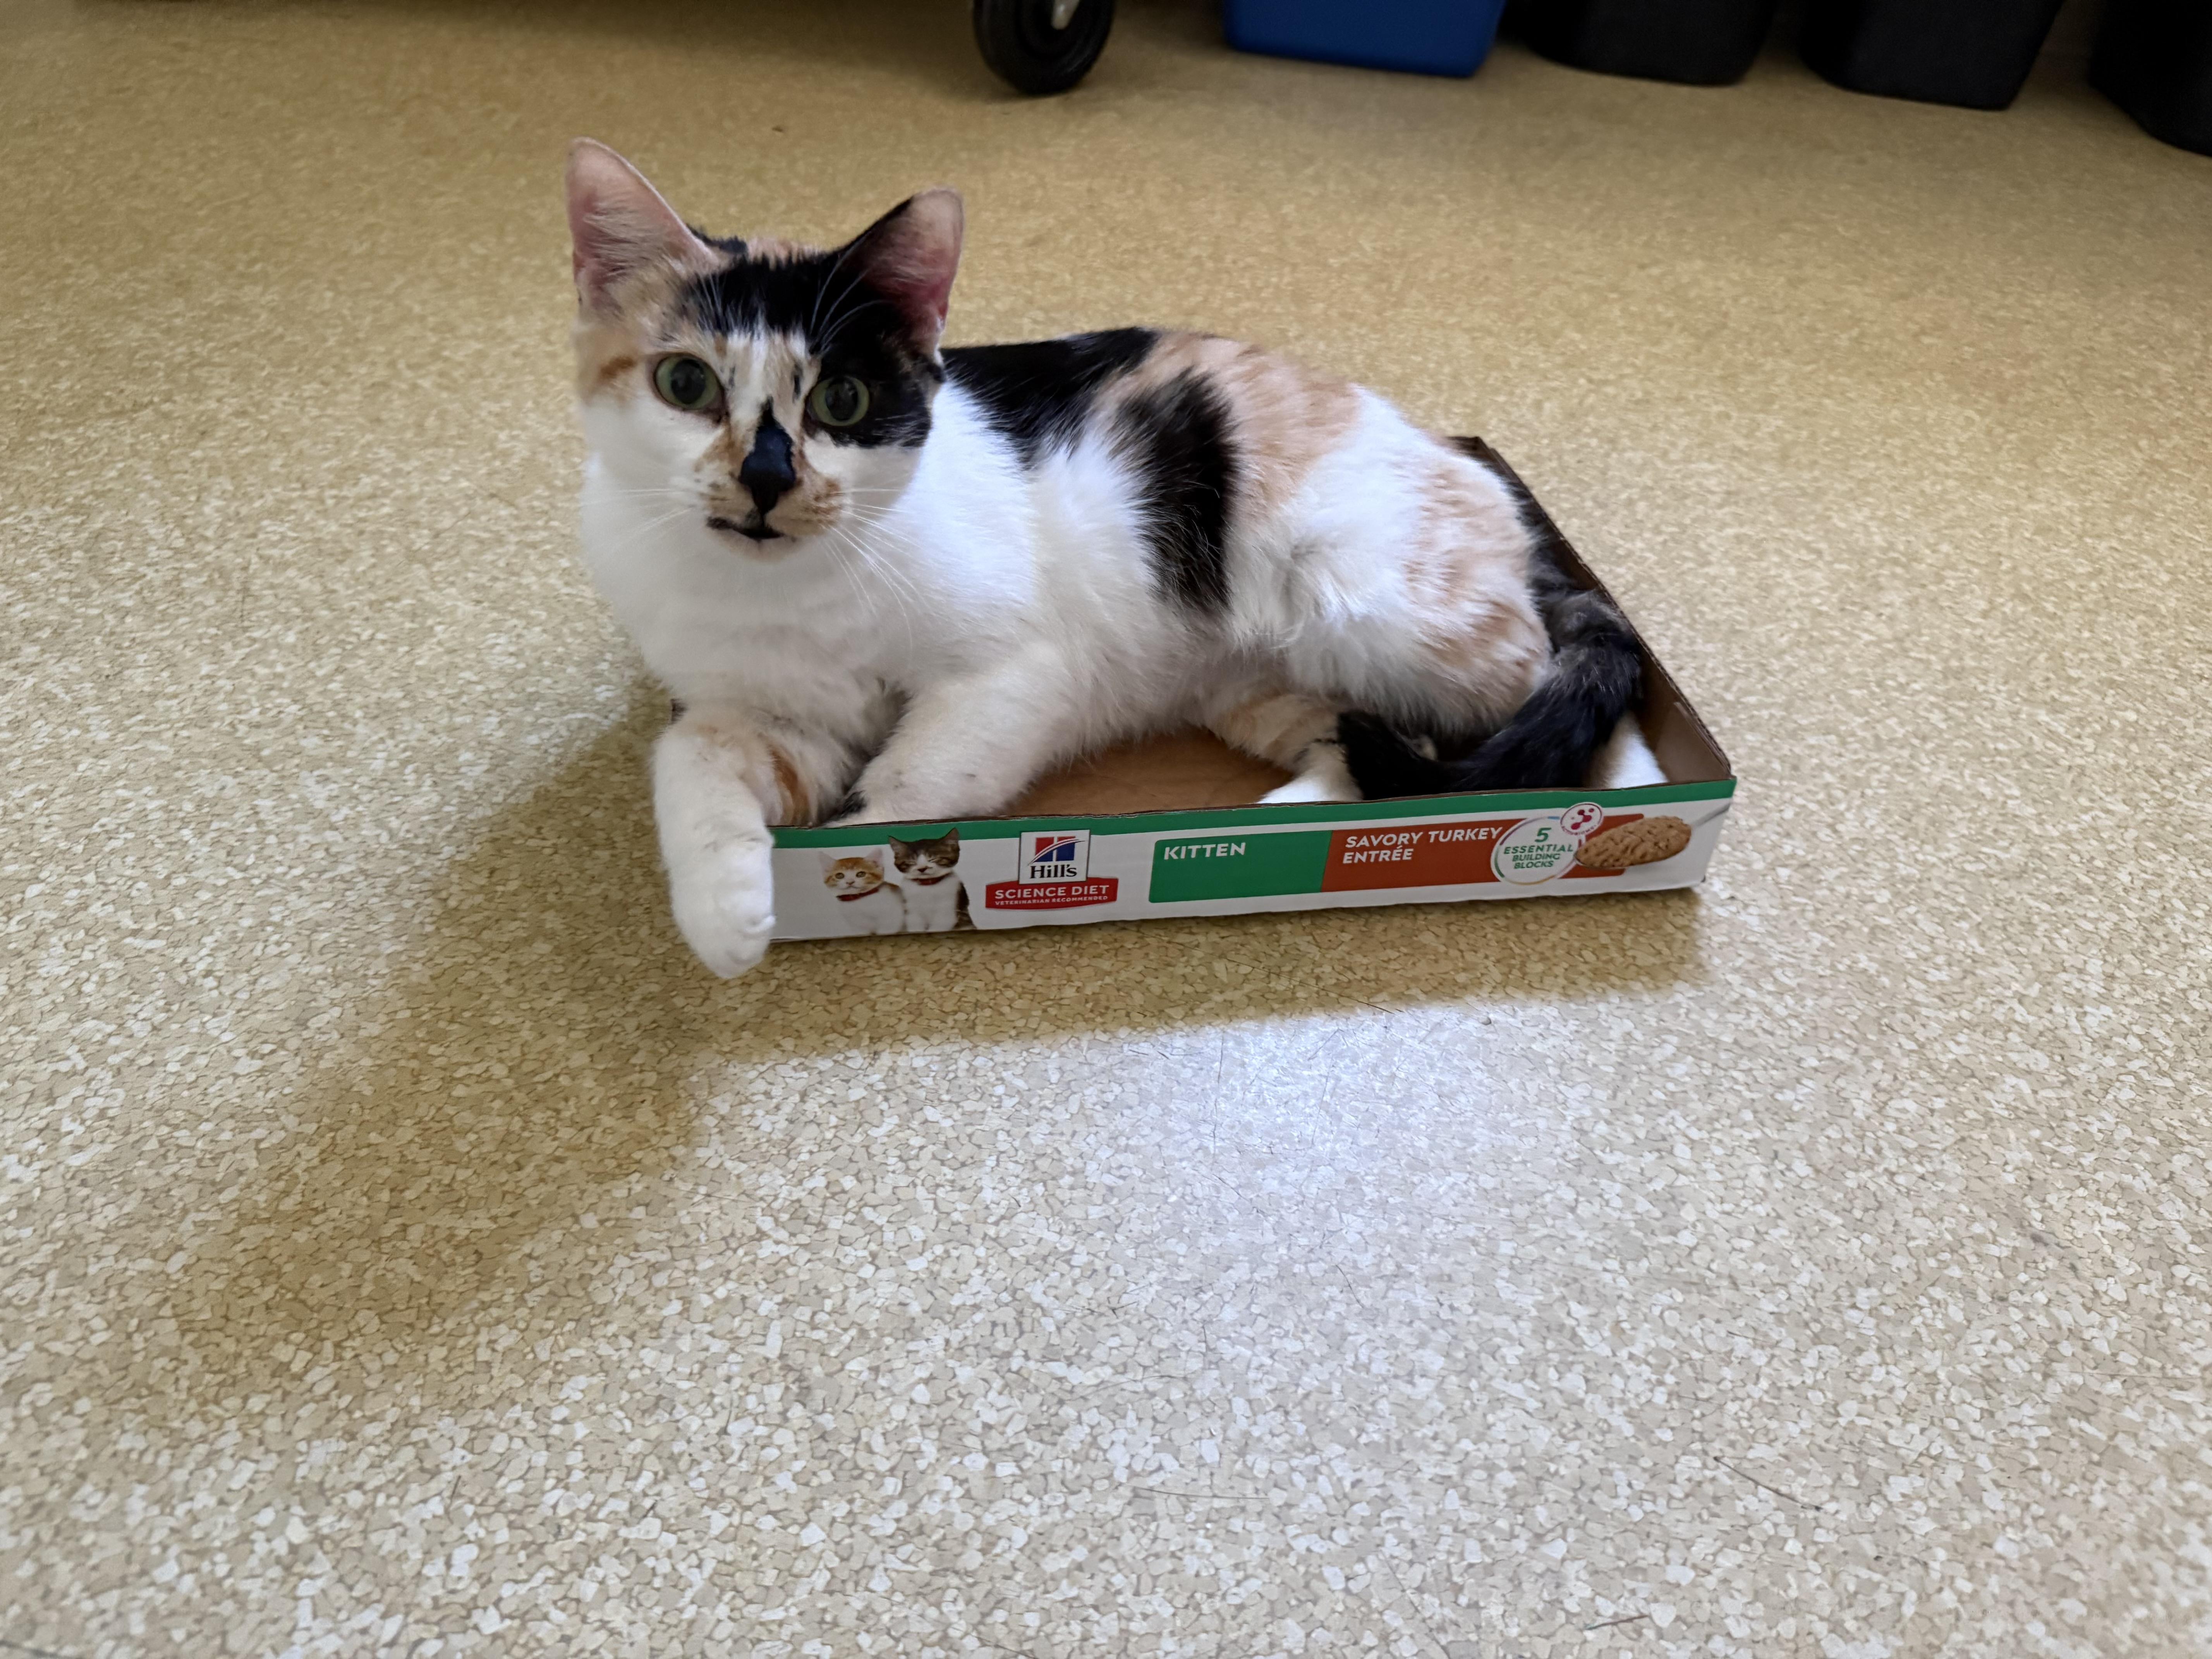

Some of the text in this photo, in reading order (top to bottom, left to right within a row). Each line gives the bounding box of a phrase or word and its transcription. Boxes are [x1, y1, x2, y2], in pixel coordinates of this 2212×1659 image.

[1345, 827, 1503, 848] SAVORY TURKEY
[1534, 827, 1552, 842] 5
[1164, 842, 1246, 860] KITTEN
[1343, 845, 1413, 864] ENTRÉE
[1504, 844, 1573, 854] ESSENTIAL
[1512, 853, 1560, 862] BUILDING
[1514, 860, 1554, 869] BLOCKS
[1030, 864, 1077, 879] Hill's
[995, 885, 1109, 899] SCIENCE DIET
